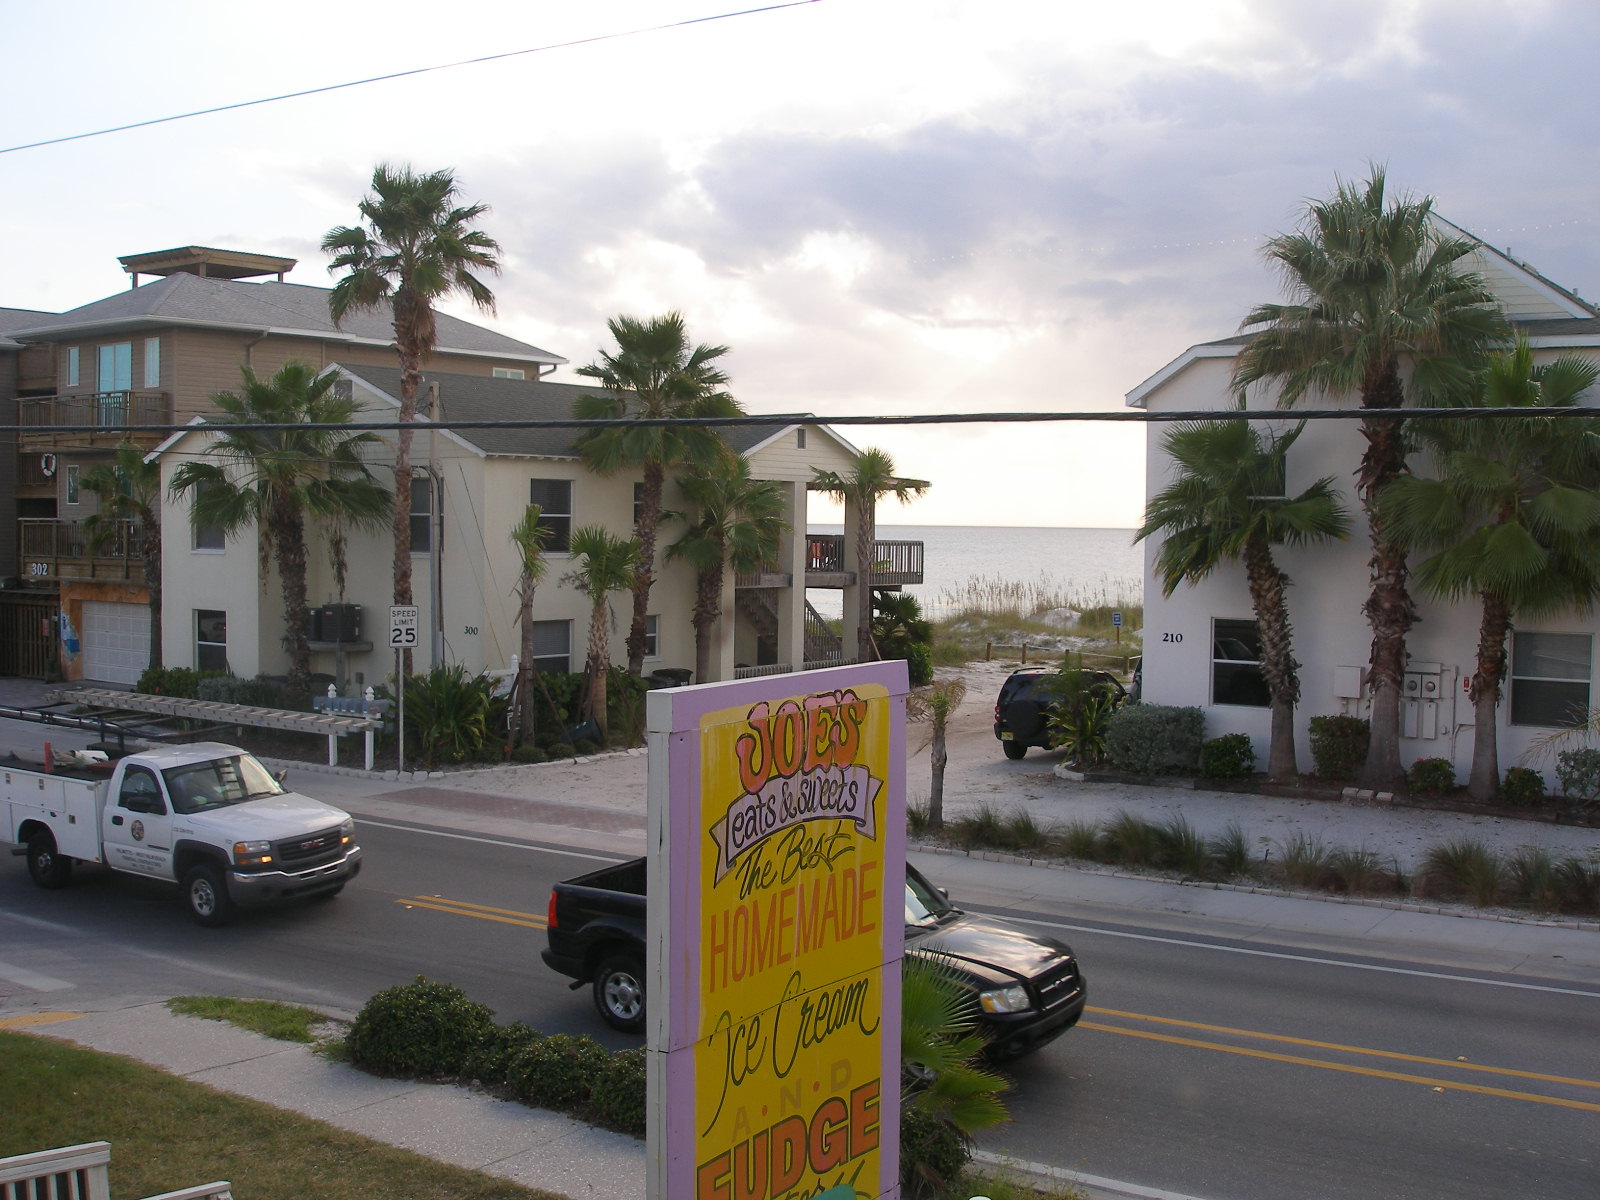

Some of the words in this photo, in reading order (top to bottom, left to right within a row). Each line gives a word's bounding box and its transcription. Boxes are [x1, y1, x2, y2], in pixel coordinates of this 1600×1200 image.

[31, 562, 48, 576] 302
[391, 610, 417, 618] SPEED
[391, 627, 416, 644] 25
[463, 625, 479, 636] 300
[1162, 632, 1183, 643] 210
[735, 688, 868, 795] JOE'S
[731, 793, 777, 849] eats
[797, 769, 859, 815] sweets
[735, 836, 778, 901] The
[777, 820, 856, 886] Best
[709, 860, 878, 993] HOMEMADE
[702, 1009, 768, 1138] Ice
[772, 970, 881, 1079] Cream
